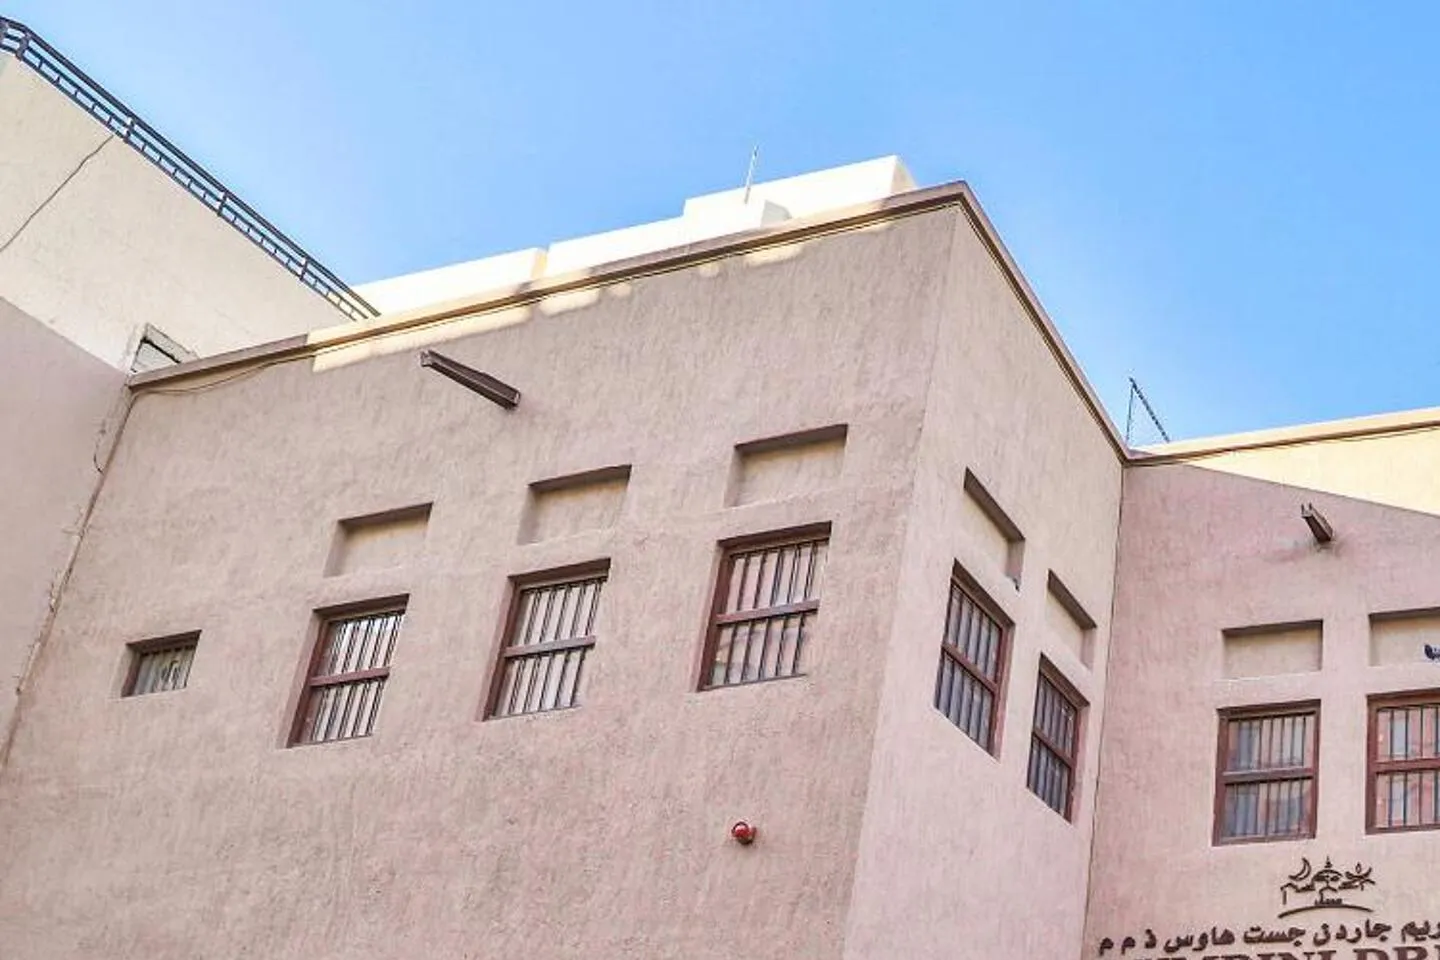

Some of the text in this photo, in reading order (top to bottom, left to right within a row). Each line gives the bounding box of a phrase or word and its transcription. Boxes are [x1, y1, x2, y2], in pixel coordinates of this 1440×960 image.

[1163, 926, 1236, 953] هاوس
[1243, 925, 1306, 947] جست
[1312, 919, 1393, 946] جاردن
